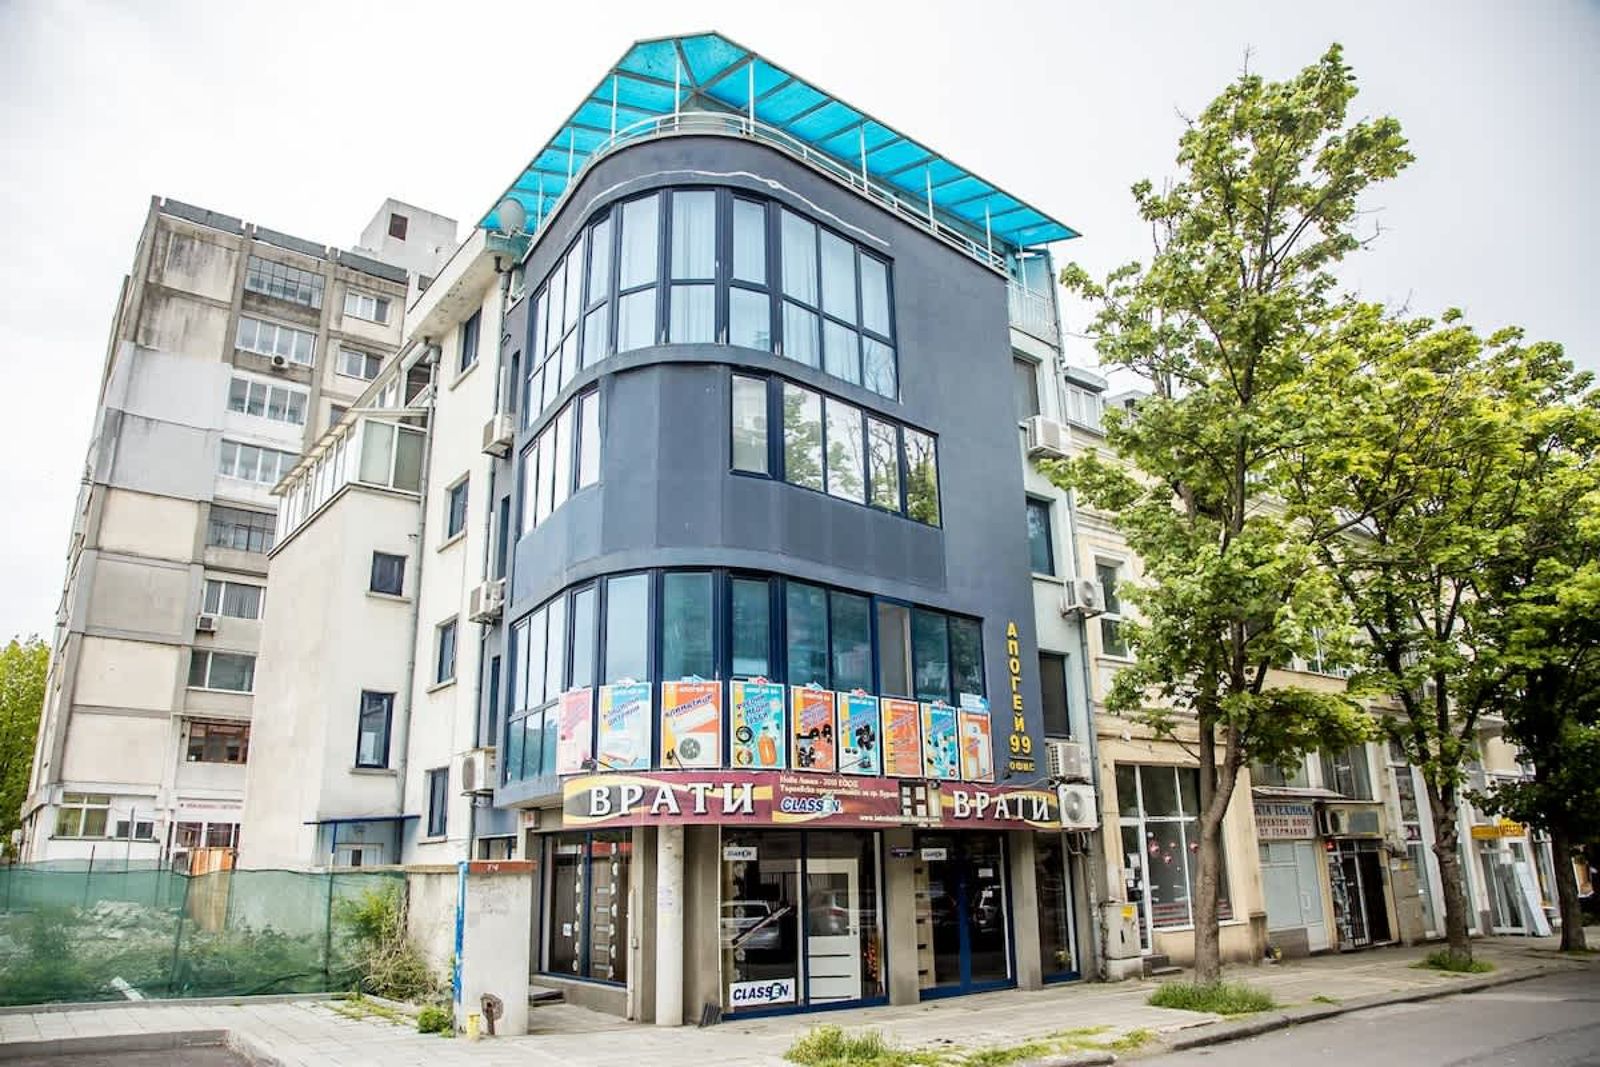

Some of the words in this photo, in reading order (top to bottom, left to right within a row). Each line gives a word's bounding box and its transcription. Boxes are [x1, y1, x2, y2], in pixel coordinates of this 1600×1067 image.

[1009, 734, 1032, 754] 99
[589, 782, 755, 817] ВРАТИ
[953, 790, 1050, 821] ВРАТИ
[733, 983, 789, 1001] CLASSEN
